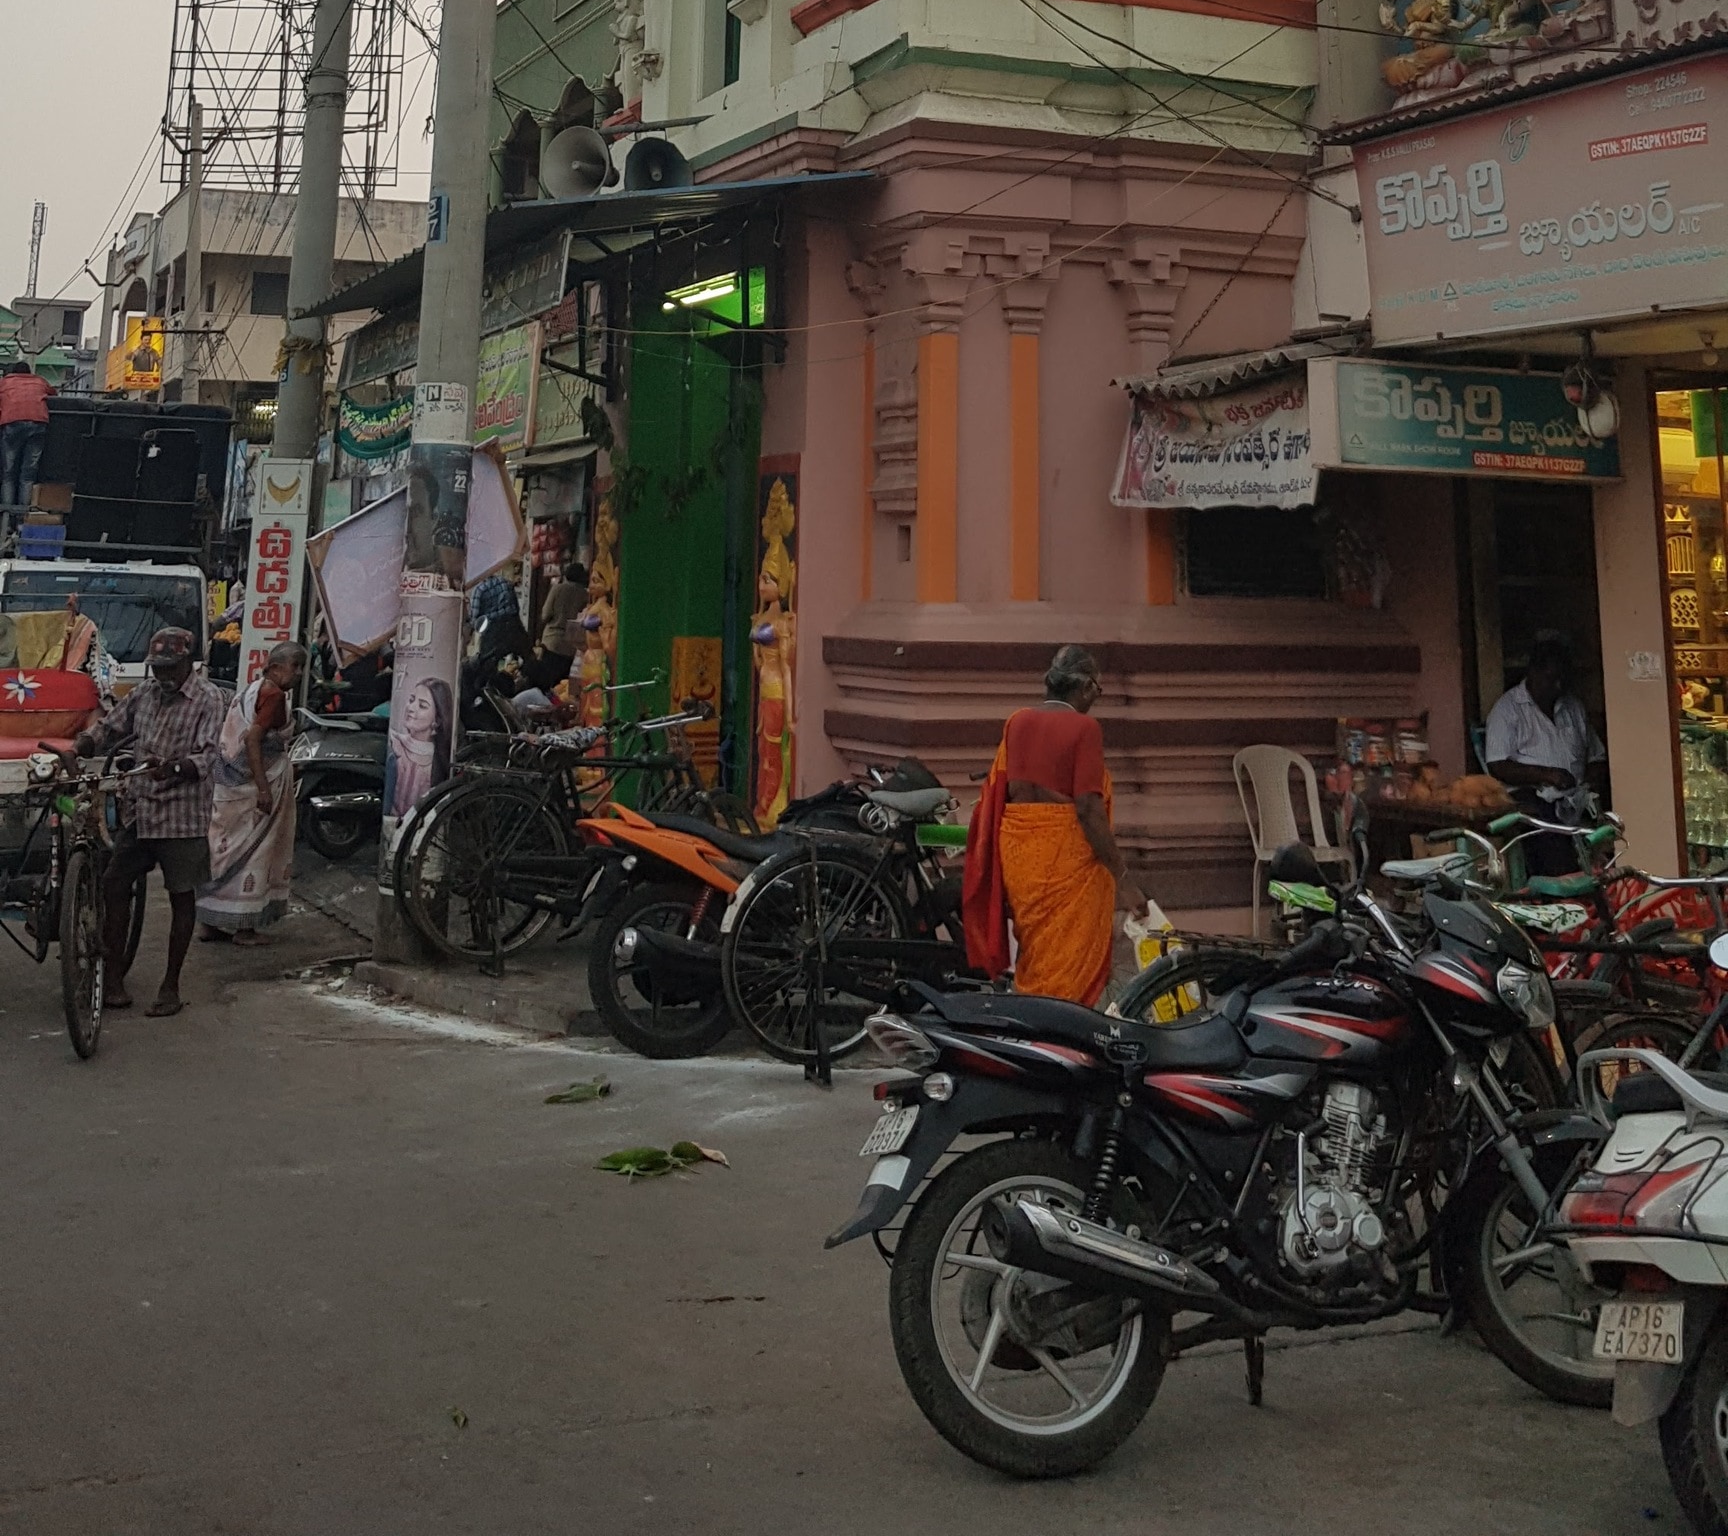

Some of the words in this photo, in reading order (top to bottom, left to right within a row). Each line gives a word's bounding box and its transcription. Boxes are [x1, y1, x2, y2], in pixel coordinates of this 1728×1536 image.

[1590, 143, 1620, 158] GSTIN:
[1473, 451, 1504, 467] GSTIN:
[1617, 1305, 1664, 1330] AP16
[1602, 1331, 1677, 1359] EA7370
